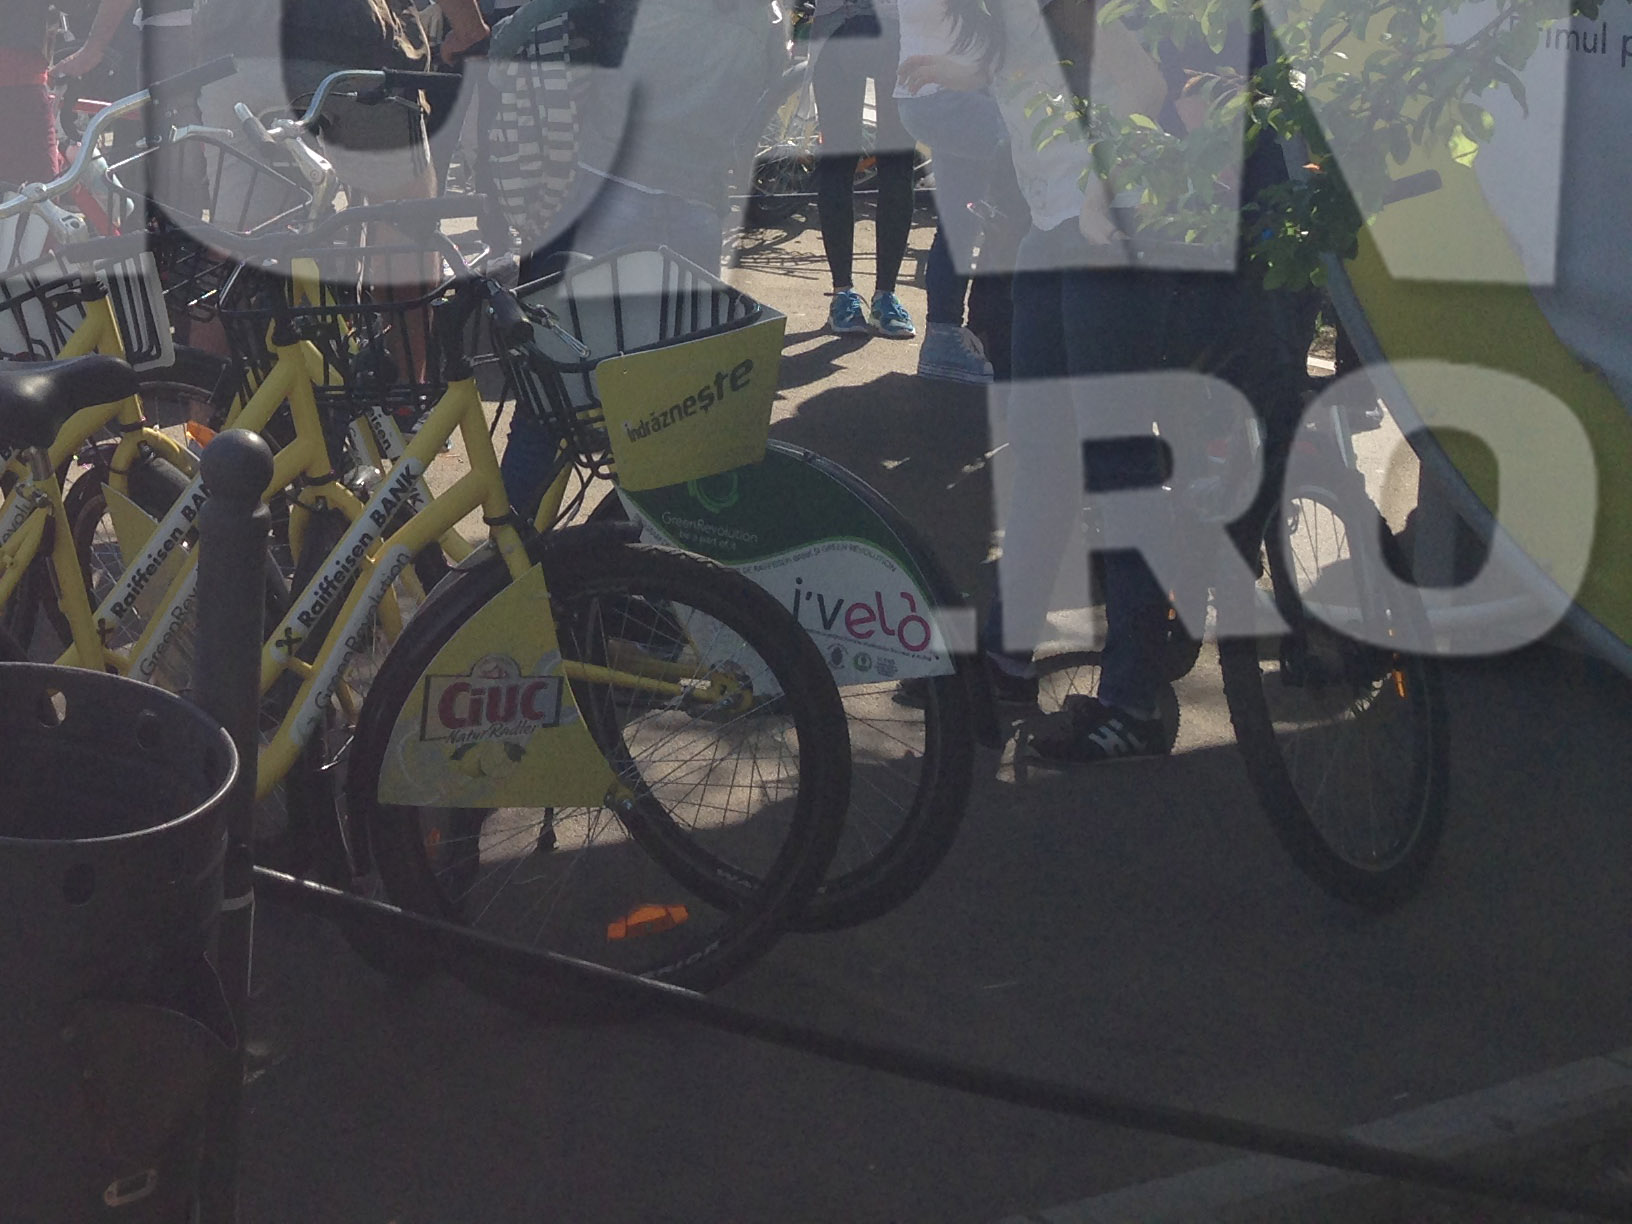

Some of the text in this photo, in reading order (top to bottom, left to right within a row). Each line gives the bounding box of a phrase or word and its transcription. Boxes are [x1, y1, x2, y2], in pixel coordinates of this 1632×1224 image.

[109, 526, 184, 620] Raiffeisen
[297, 463, 422, 628] Raiffeisen BANK
